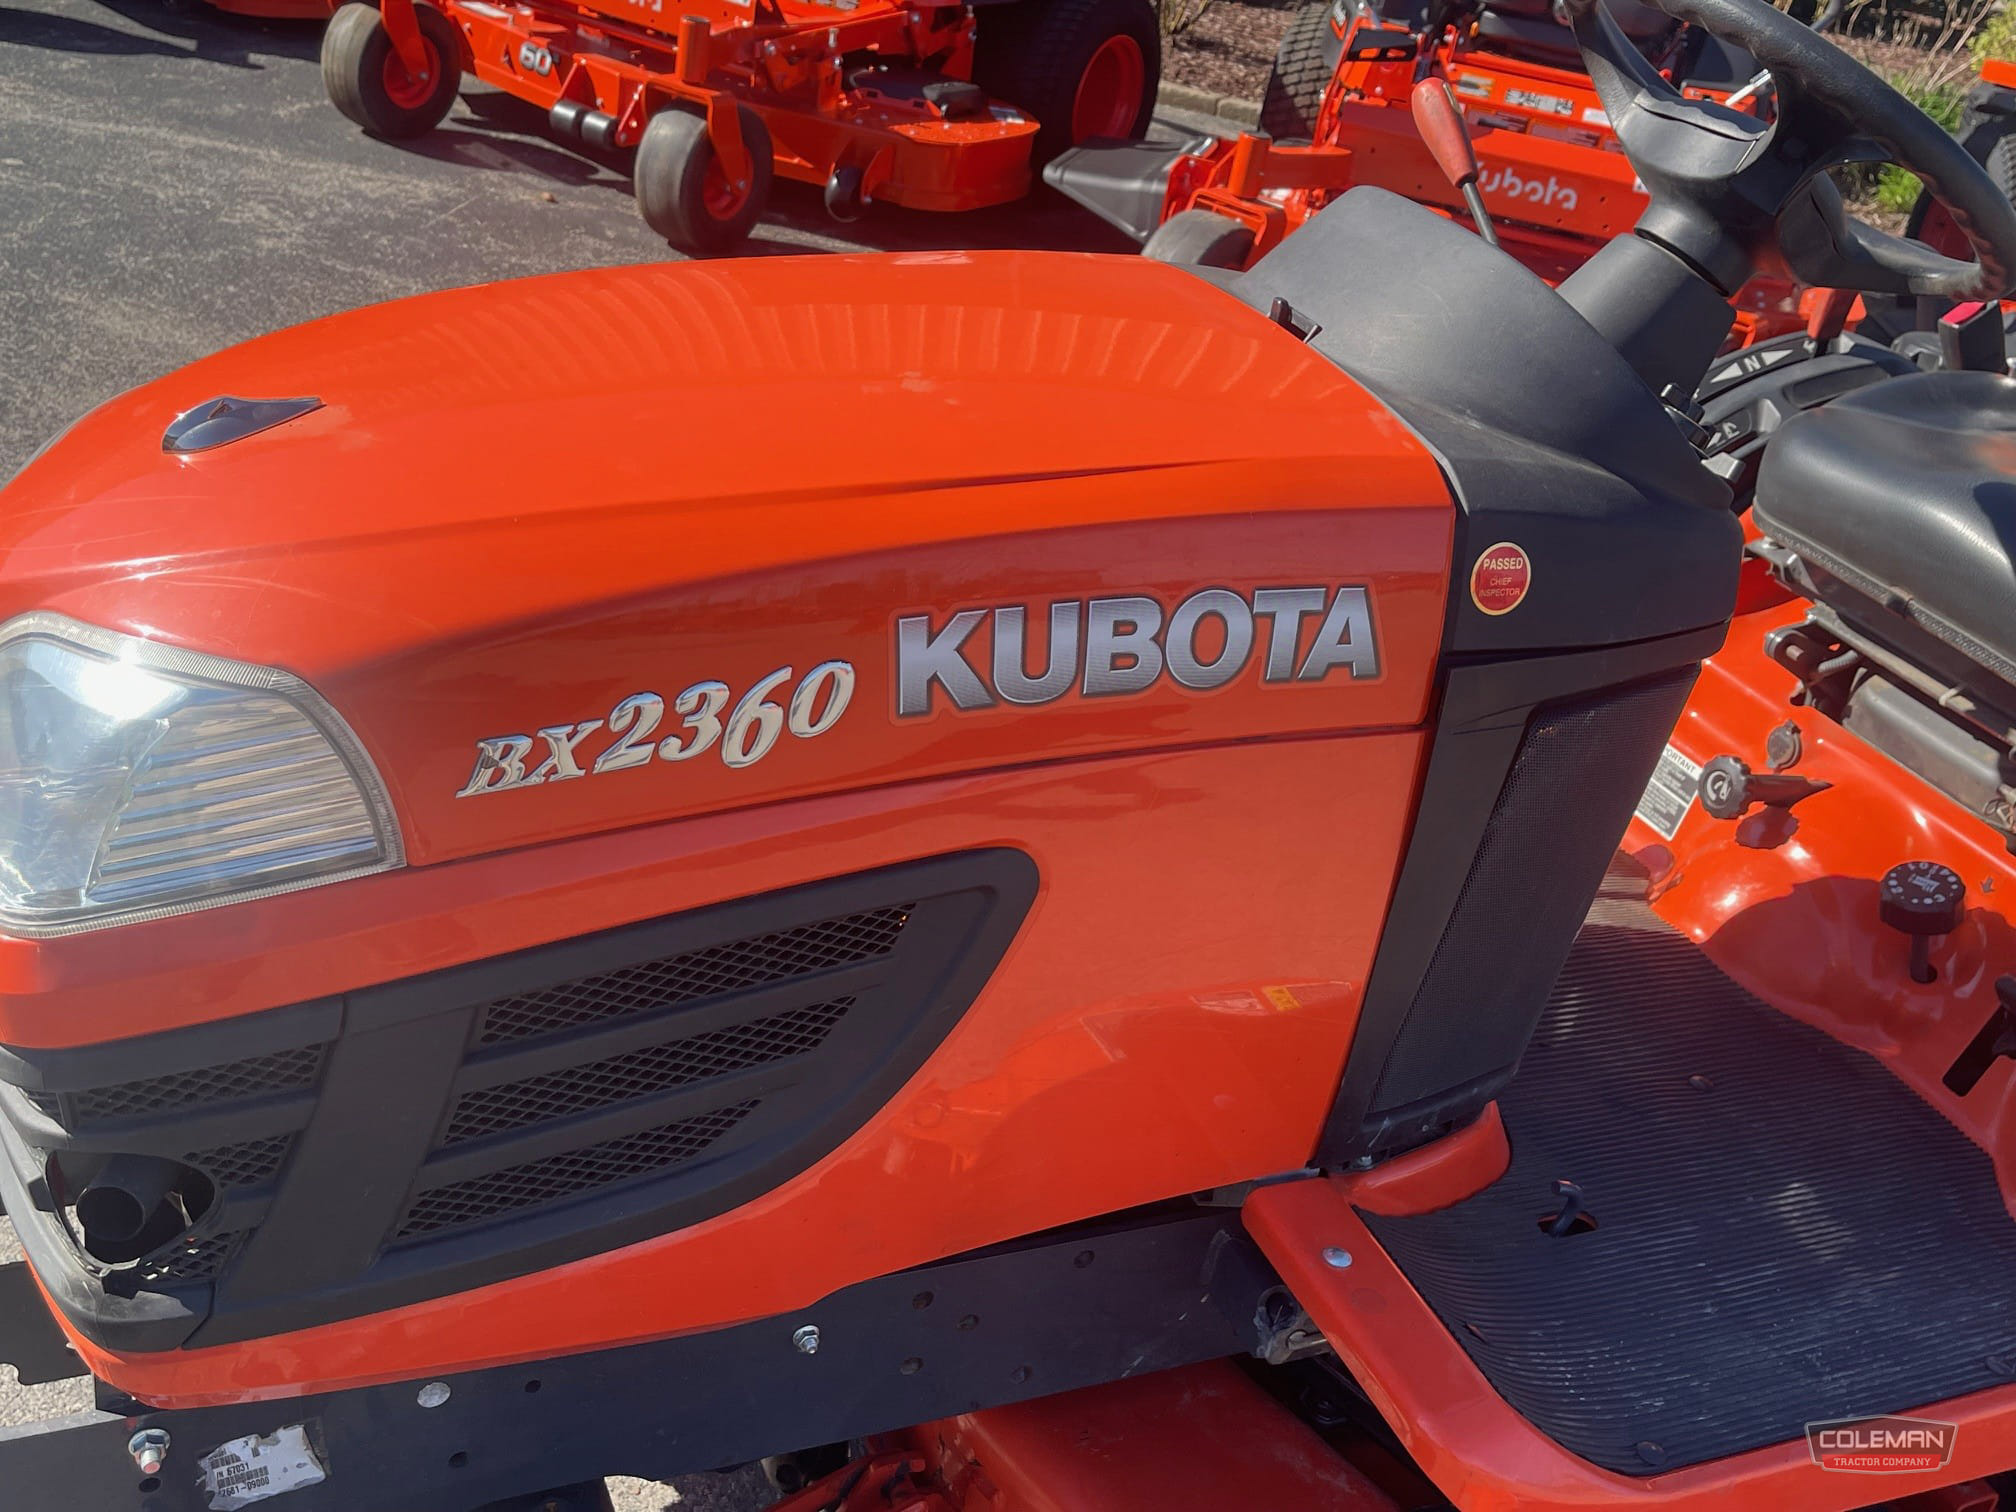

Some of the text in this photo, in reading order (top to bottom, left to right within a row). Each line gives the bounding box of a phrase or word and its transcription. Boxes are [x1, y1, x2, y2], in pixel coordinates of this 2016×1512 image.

[1476, 160, 1578, 210] ubota
[1743, 355, 1762, 373] N
[1483, 557, 1524, 571] PASSED
[1490, 576, 1513, 586] CHIEF
[1479, 587, 1521, 598] INSPECTOR
[897, 585, 1380, 717] KUBOTA
[455, 659, 856, 800] BX2360
